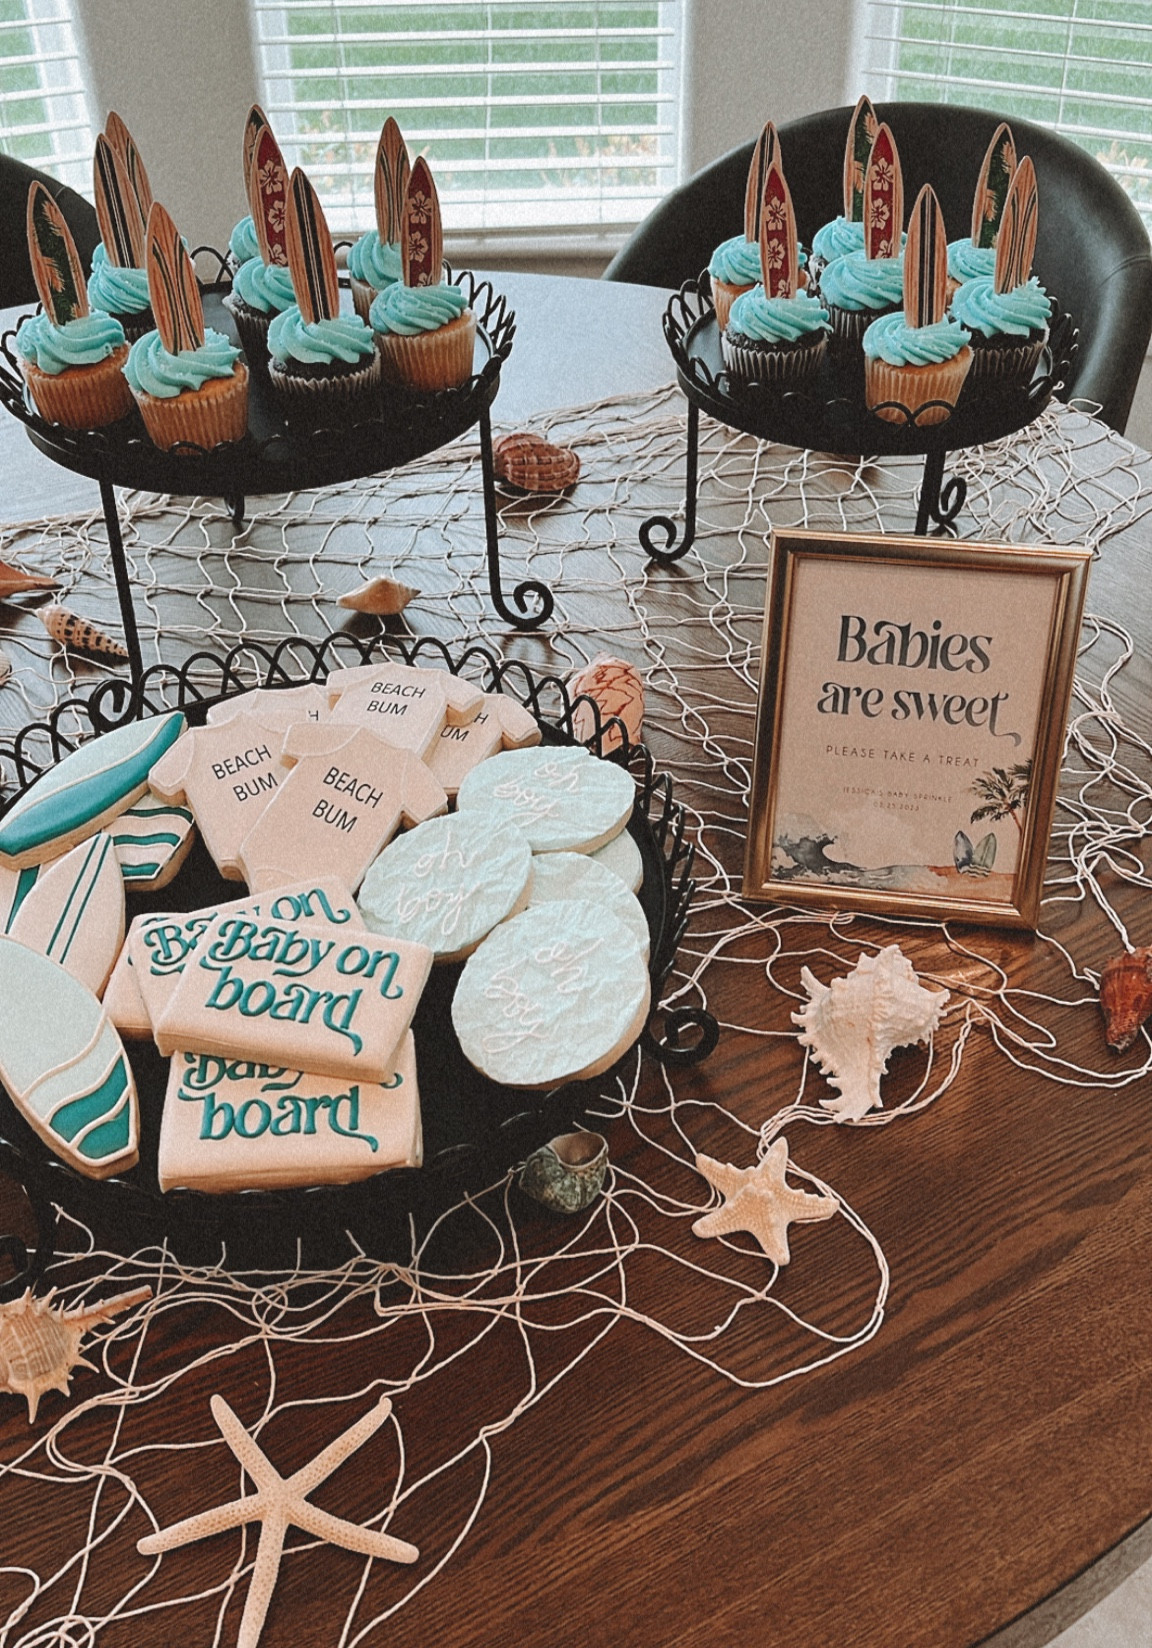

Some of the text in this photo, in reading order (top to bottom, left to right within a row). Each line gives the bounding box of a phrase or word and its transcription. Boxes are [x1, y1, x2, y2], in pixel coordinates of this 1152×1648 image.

[837, 615, 993, 673] Babies
[367, 700, 408, 716] BUM
[371, 682, 426, 699] BEACH
[440, 725, 469, 742] UM
[816, 682, 1022, 747] are sweet
[211, 744, 272, 781] BEACH
[826, 745, 979, 767] PLEASE TAKE A TREAT
[233, 772, 278, 802] BUM
[323, 766, 384, 808] BEACH
[312, 799, 358, 834] BUM
[413, 831, 479, 878] oh
[396, 883, 482, 936] boy
[208, 919, 336, 977] Baby
[336, 945, 404, 999] on
[200, 956, 363, 1056] board
[177, 1085, 379, 1153] board
